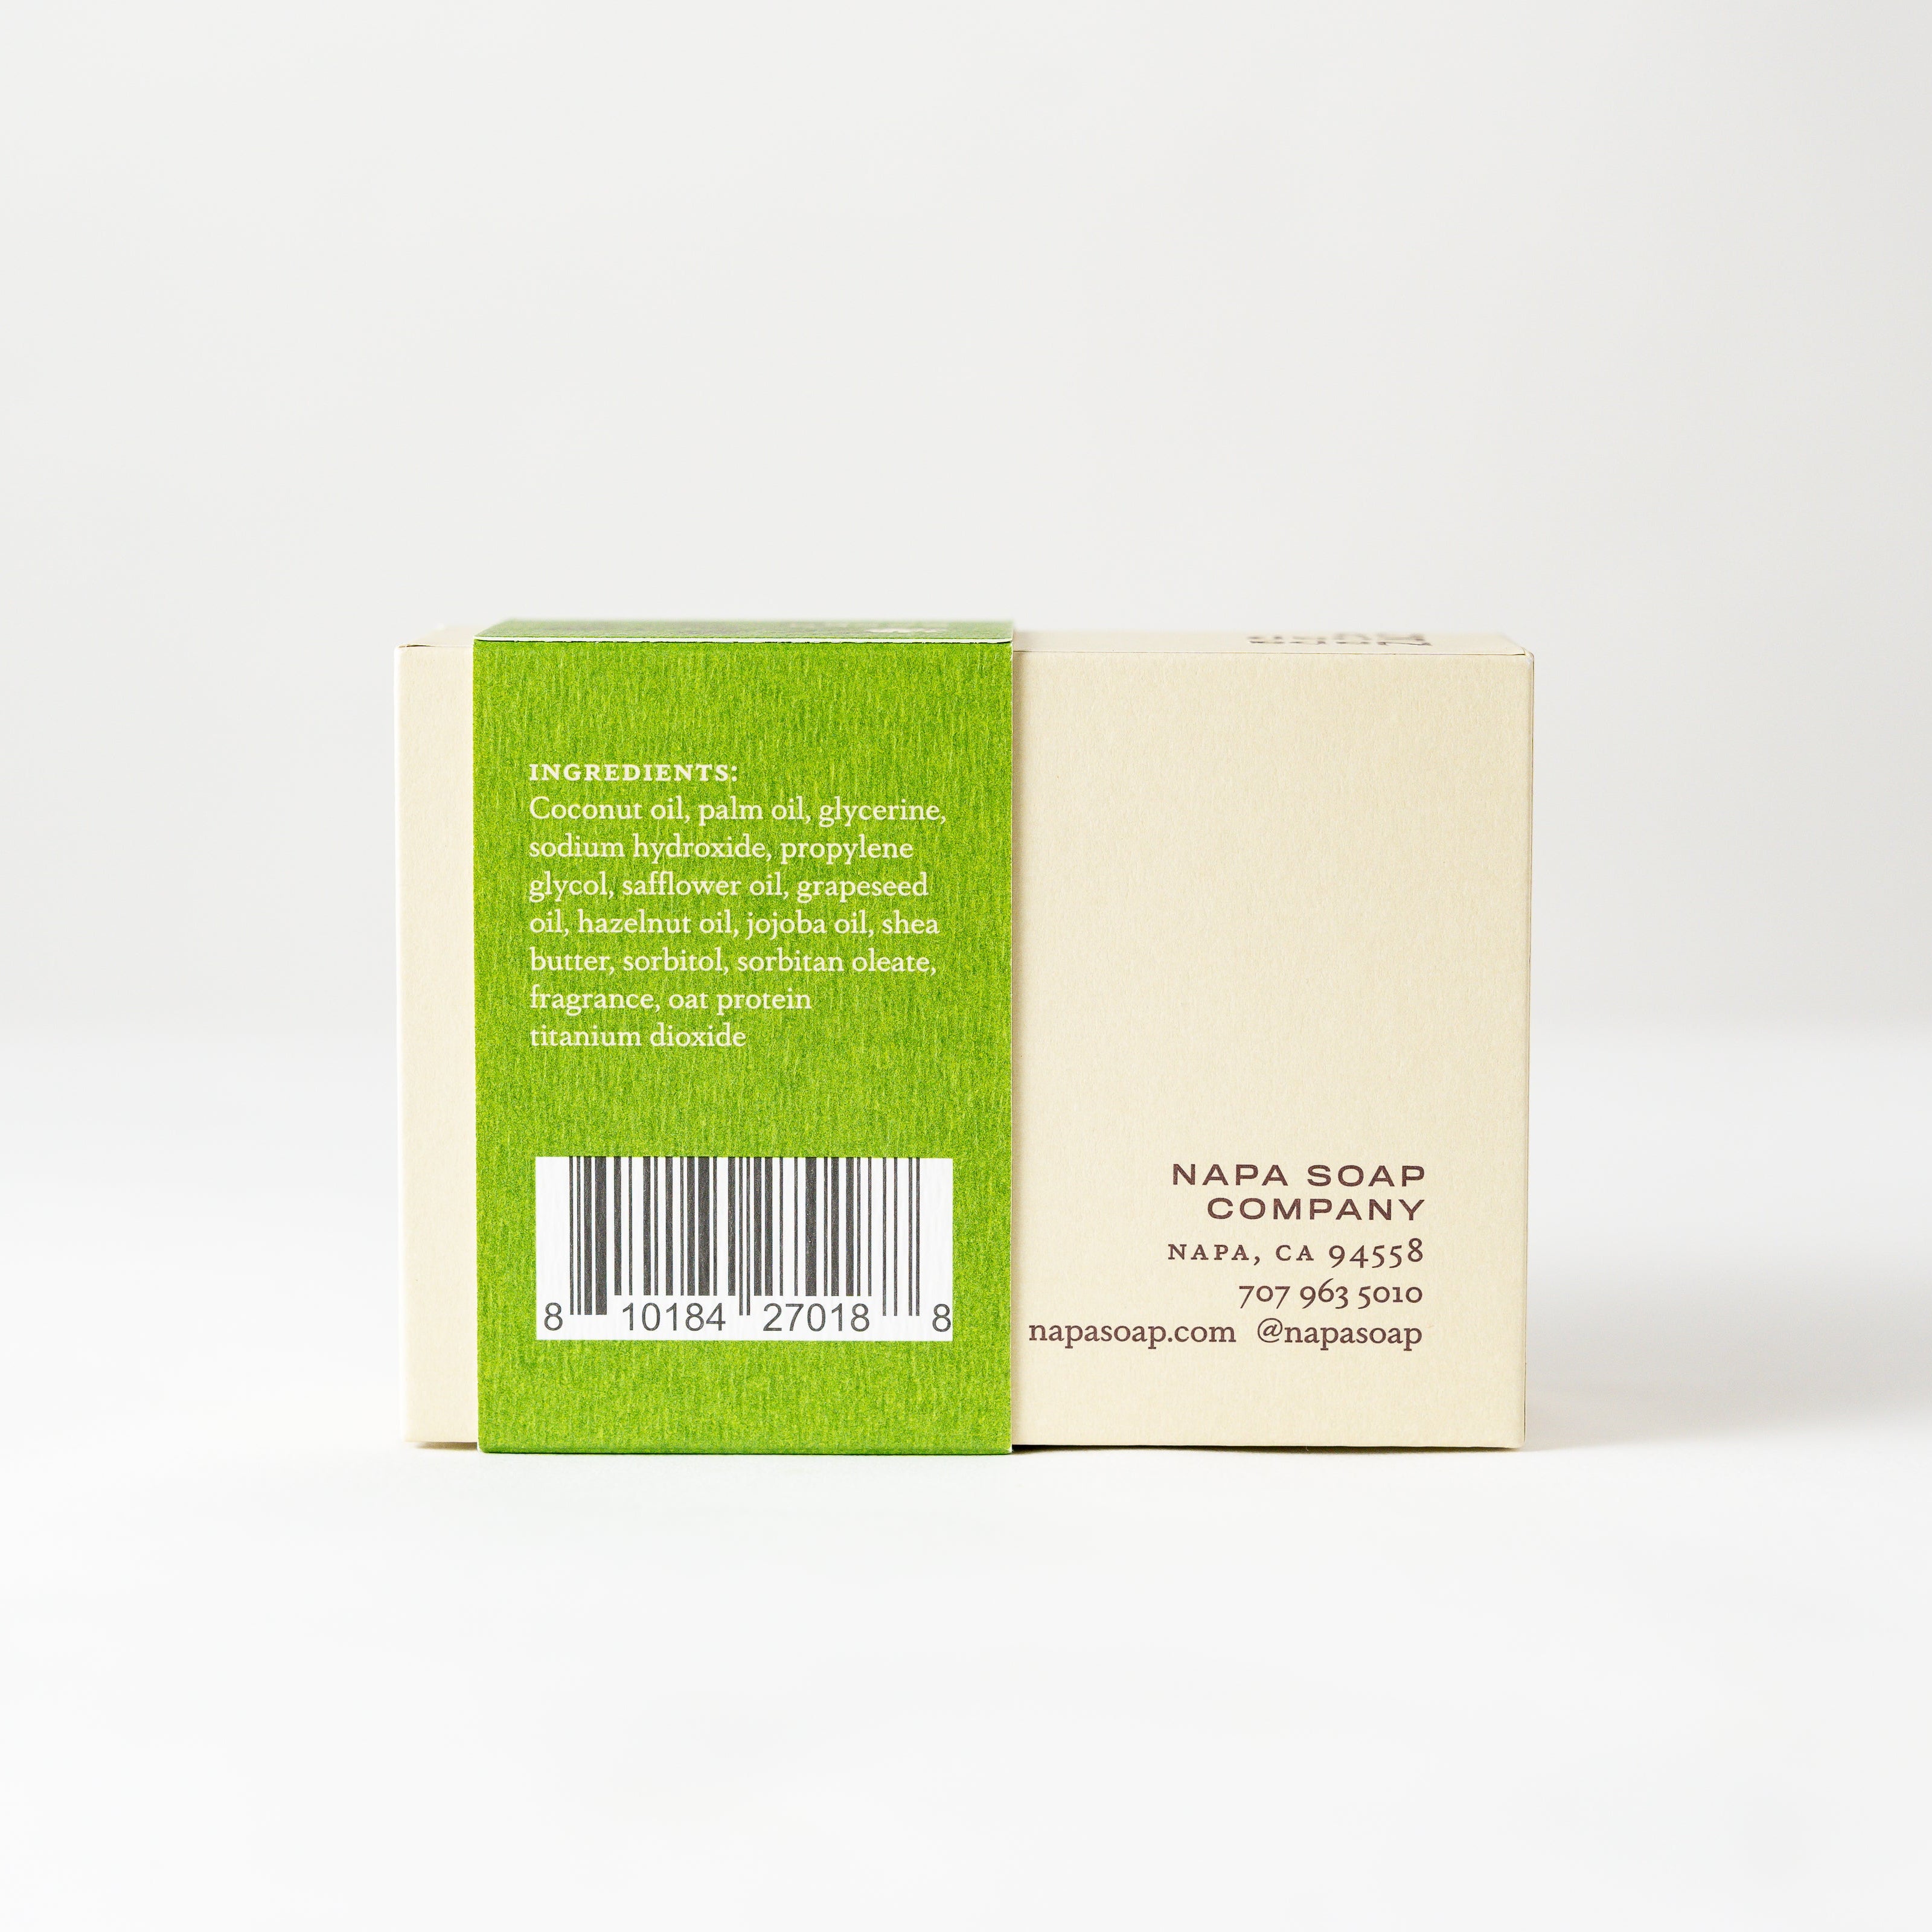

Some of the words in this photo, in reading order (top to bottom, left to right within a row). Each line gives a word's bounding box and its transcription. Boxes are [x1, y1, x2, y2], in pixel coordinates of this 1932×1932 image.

[529, 763, 737, 782] INGREDIENTS:
[529, 796, 642, 820] Coconut
[650, 795, 690, 823] oil,
[698, 795, 763, 827] palm
[772, 795, 811, 824] oil,
[819, 796, 946, 828] glycerine,
[529, 832, 625, 857] sodium
[632, 833, 772, 864] hydroxide,
[780, 833, 913, 865] propylene
[529, 871, 614, 903] glycol,
[622, 870, 741, 896] safflower
[749, 871, 789, 900] oil,
[797, 871, 929, 904] grapeseed
[529, 909, 569, 936] oil,
[577, 908, 691, 934] hazelnut
[699, 909, 739, 938] oil,
[746, 909, 827, 940] jojoba
[834, 909, 874, 938] oil,
[882, 909, 940, 934] shea
[529, 946, 615, 975] butter,
[623, 946, 729, 975] sorbitol,
[737, 947, 844, 972] sorbitan
[852, 947, 936, 976] oleate,
[530, 984, 661, 1017] fragrance,
[668, 993, 708, 1009] oat
[716, 987, 811, 1016] protein
[530, 1025, 642, 1047] titanium
[650, 1022, 746, 1047] dioxide
[1172, 1163, 1288, 1186] NAPA
[1307, 1164, 1425, 1187] SOAP
[1207, 1197, 1425, 1221] COMPANY
[1168, 1244, 1261, 1266] NAPA,
[1275, 1244, 1314, 1261] CA
[1328, 1237, 1423, 1268] 94558
[1239, 1285, 1291, 1310] 707
[1299, 1278, 1349, 1310] 963
[1358, 1285, 1423, 1310] 5010
[544, 1302, 563, 1331] 8
[622, 1302, 726, 1331] 10184
[763, 1303, 870, 1332] 27018
[932, 1303, 952, 1332] 8
[1028, 1325, 1236, 1350] napasoap.com
[1257, 1317, 1422, 1352] @napasoap
